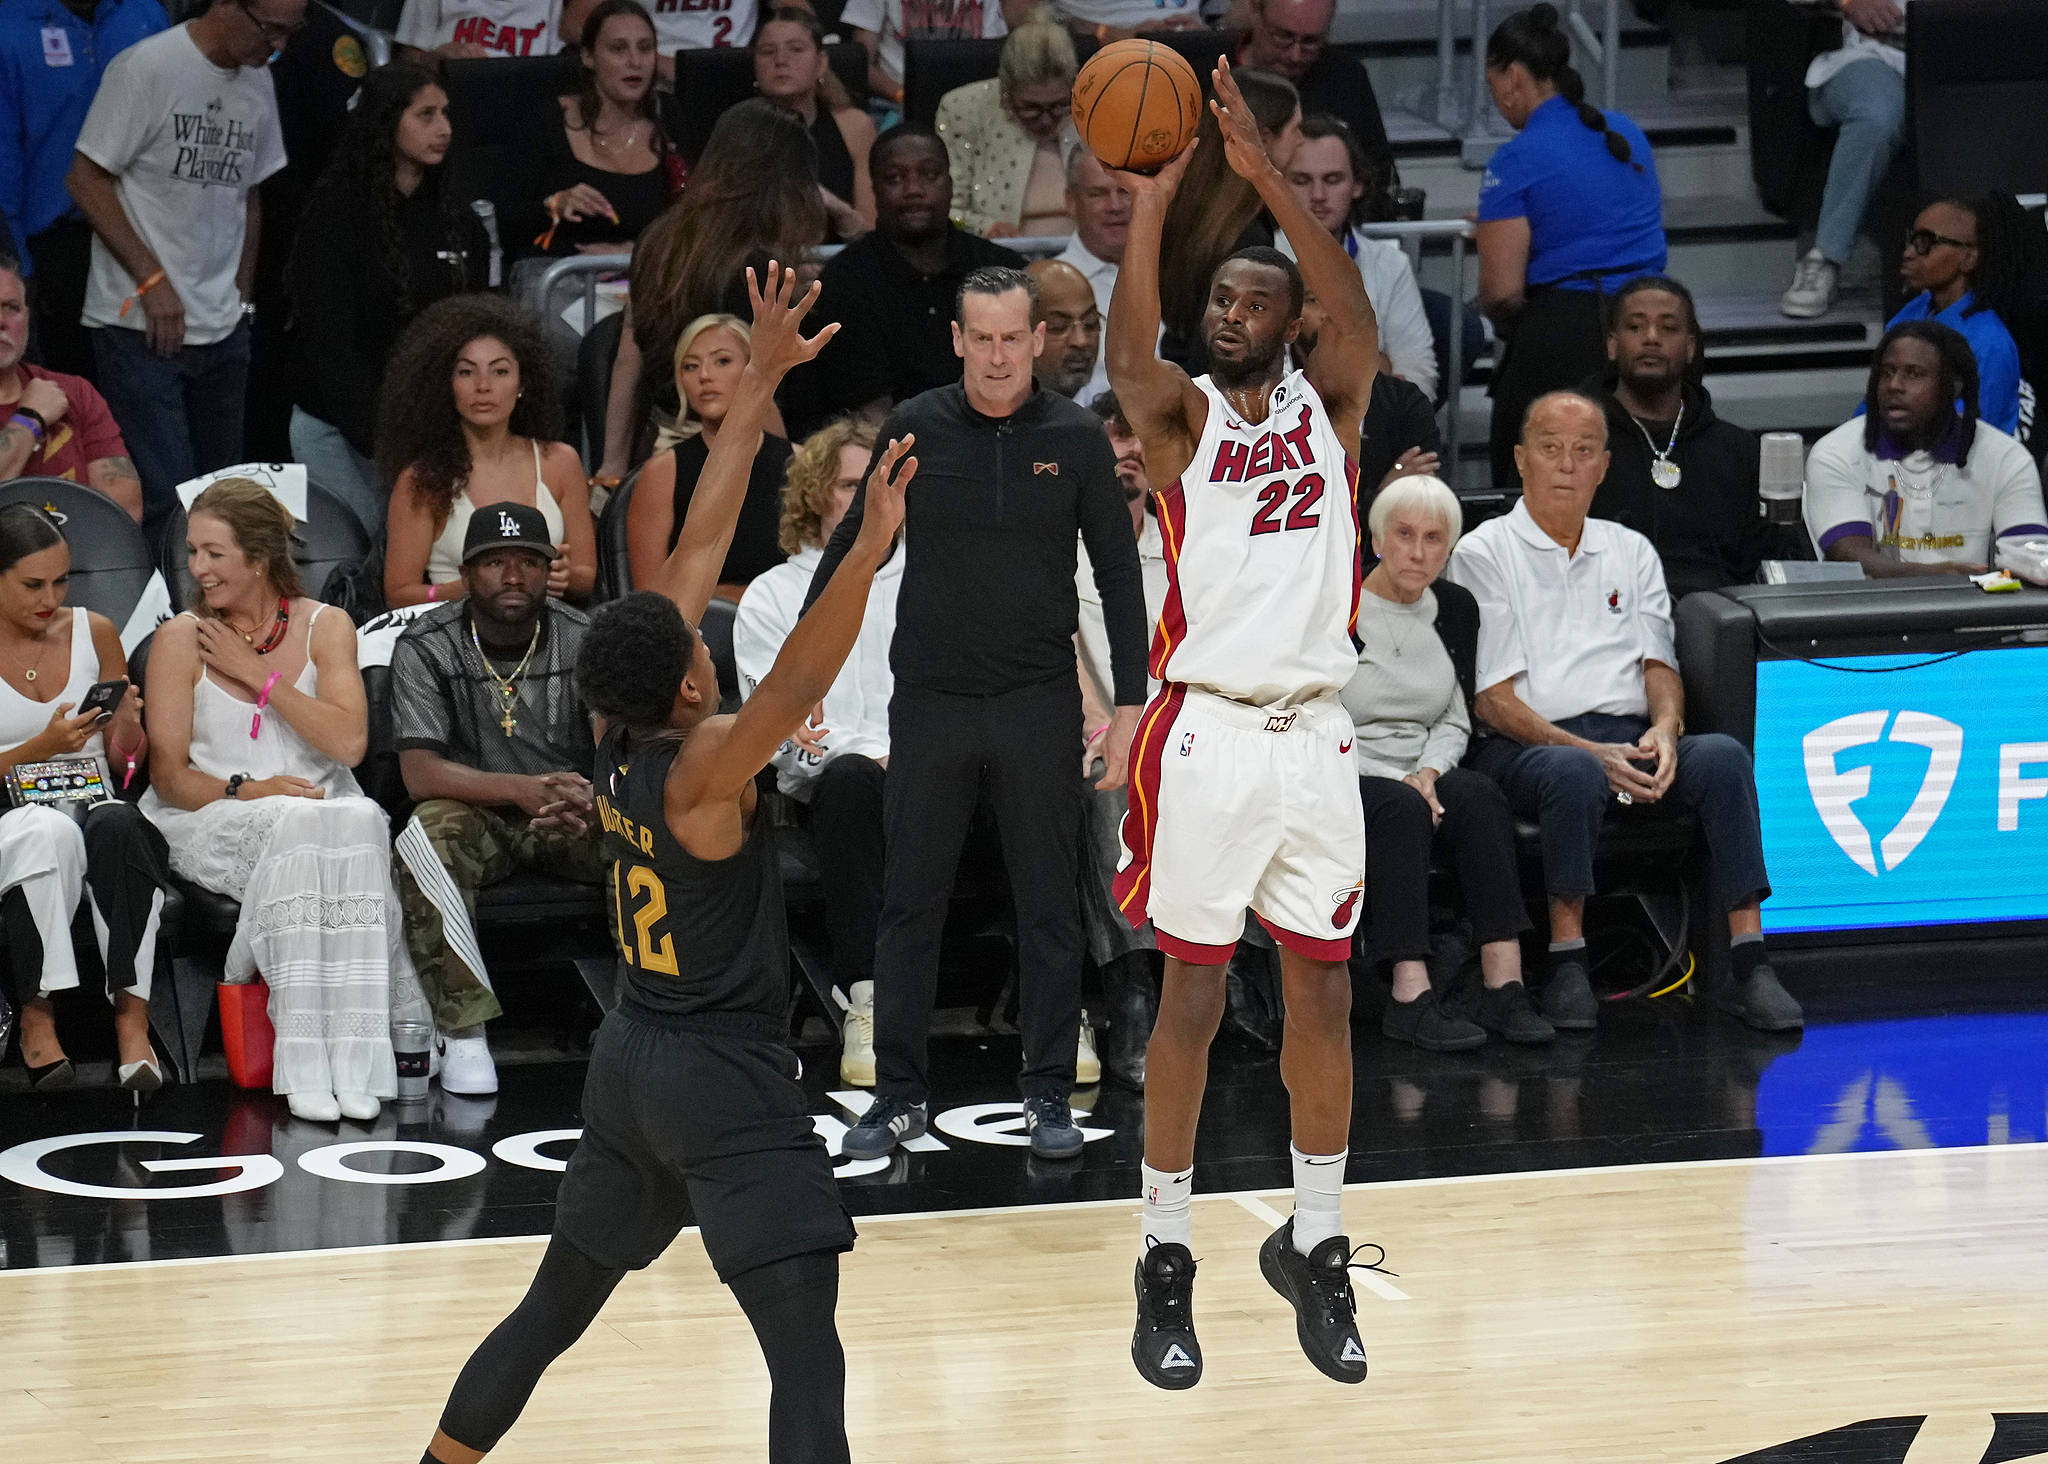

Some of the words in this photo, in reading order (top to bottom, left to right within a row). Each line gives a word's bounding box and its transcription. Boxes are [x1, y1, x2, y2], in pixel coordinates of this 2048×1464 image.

[453, 16, 546, 57] HEAT
[712, 16, 731, 48] 2
[174, 113, 223, 146] White
[1274, 393, 1304, 415] obinhood
[1209, 403, 1316, 482] HEAT
[1249, 472, 1326, 537] 22
[498, 511, 521, 537] LA
[613, 858, 680, 977] 12
